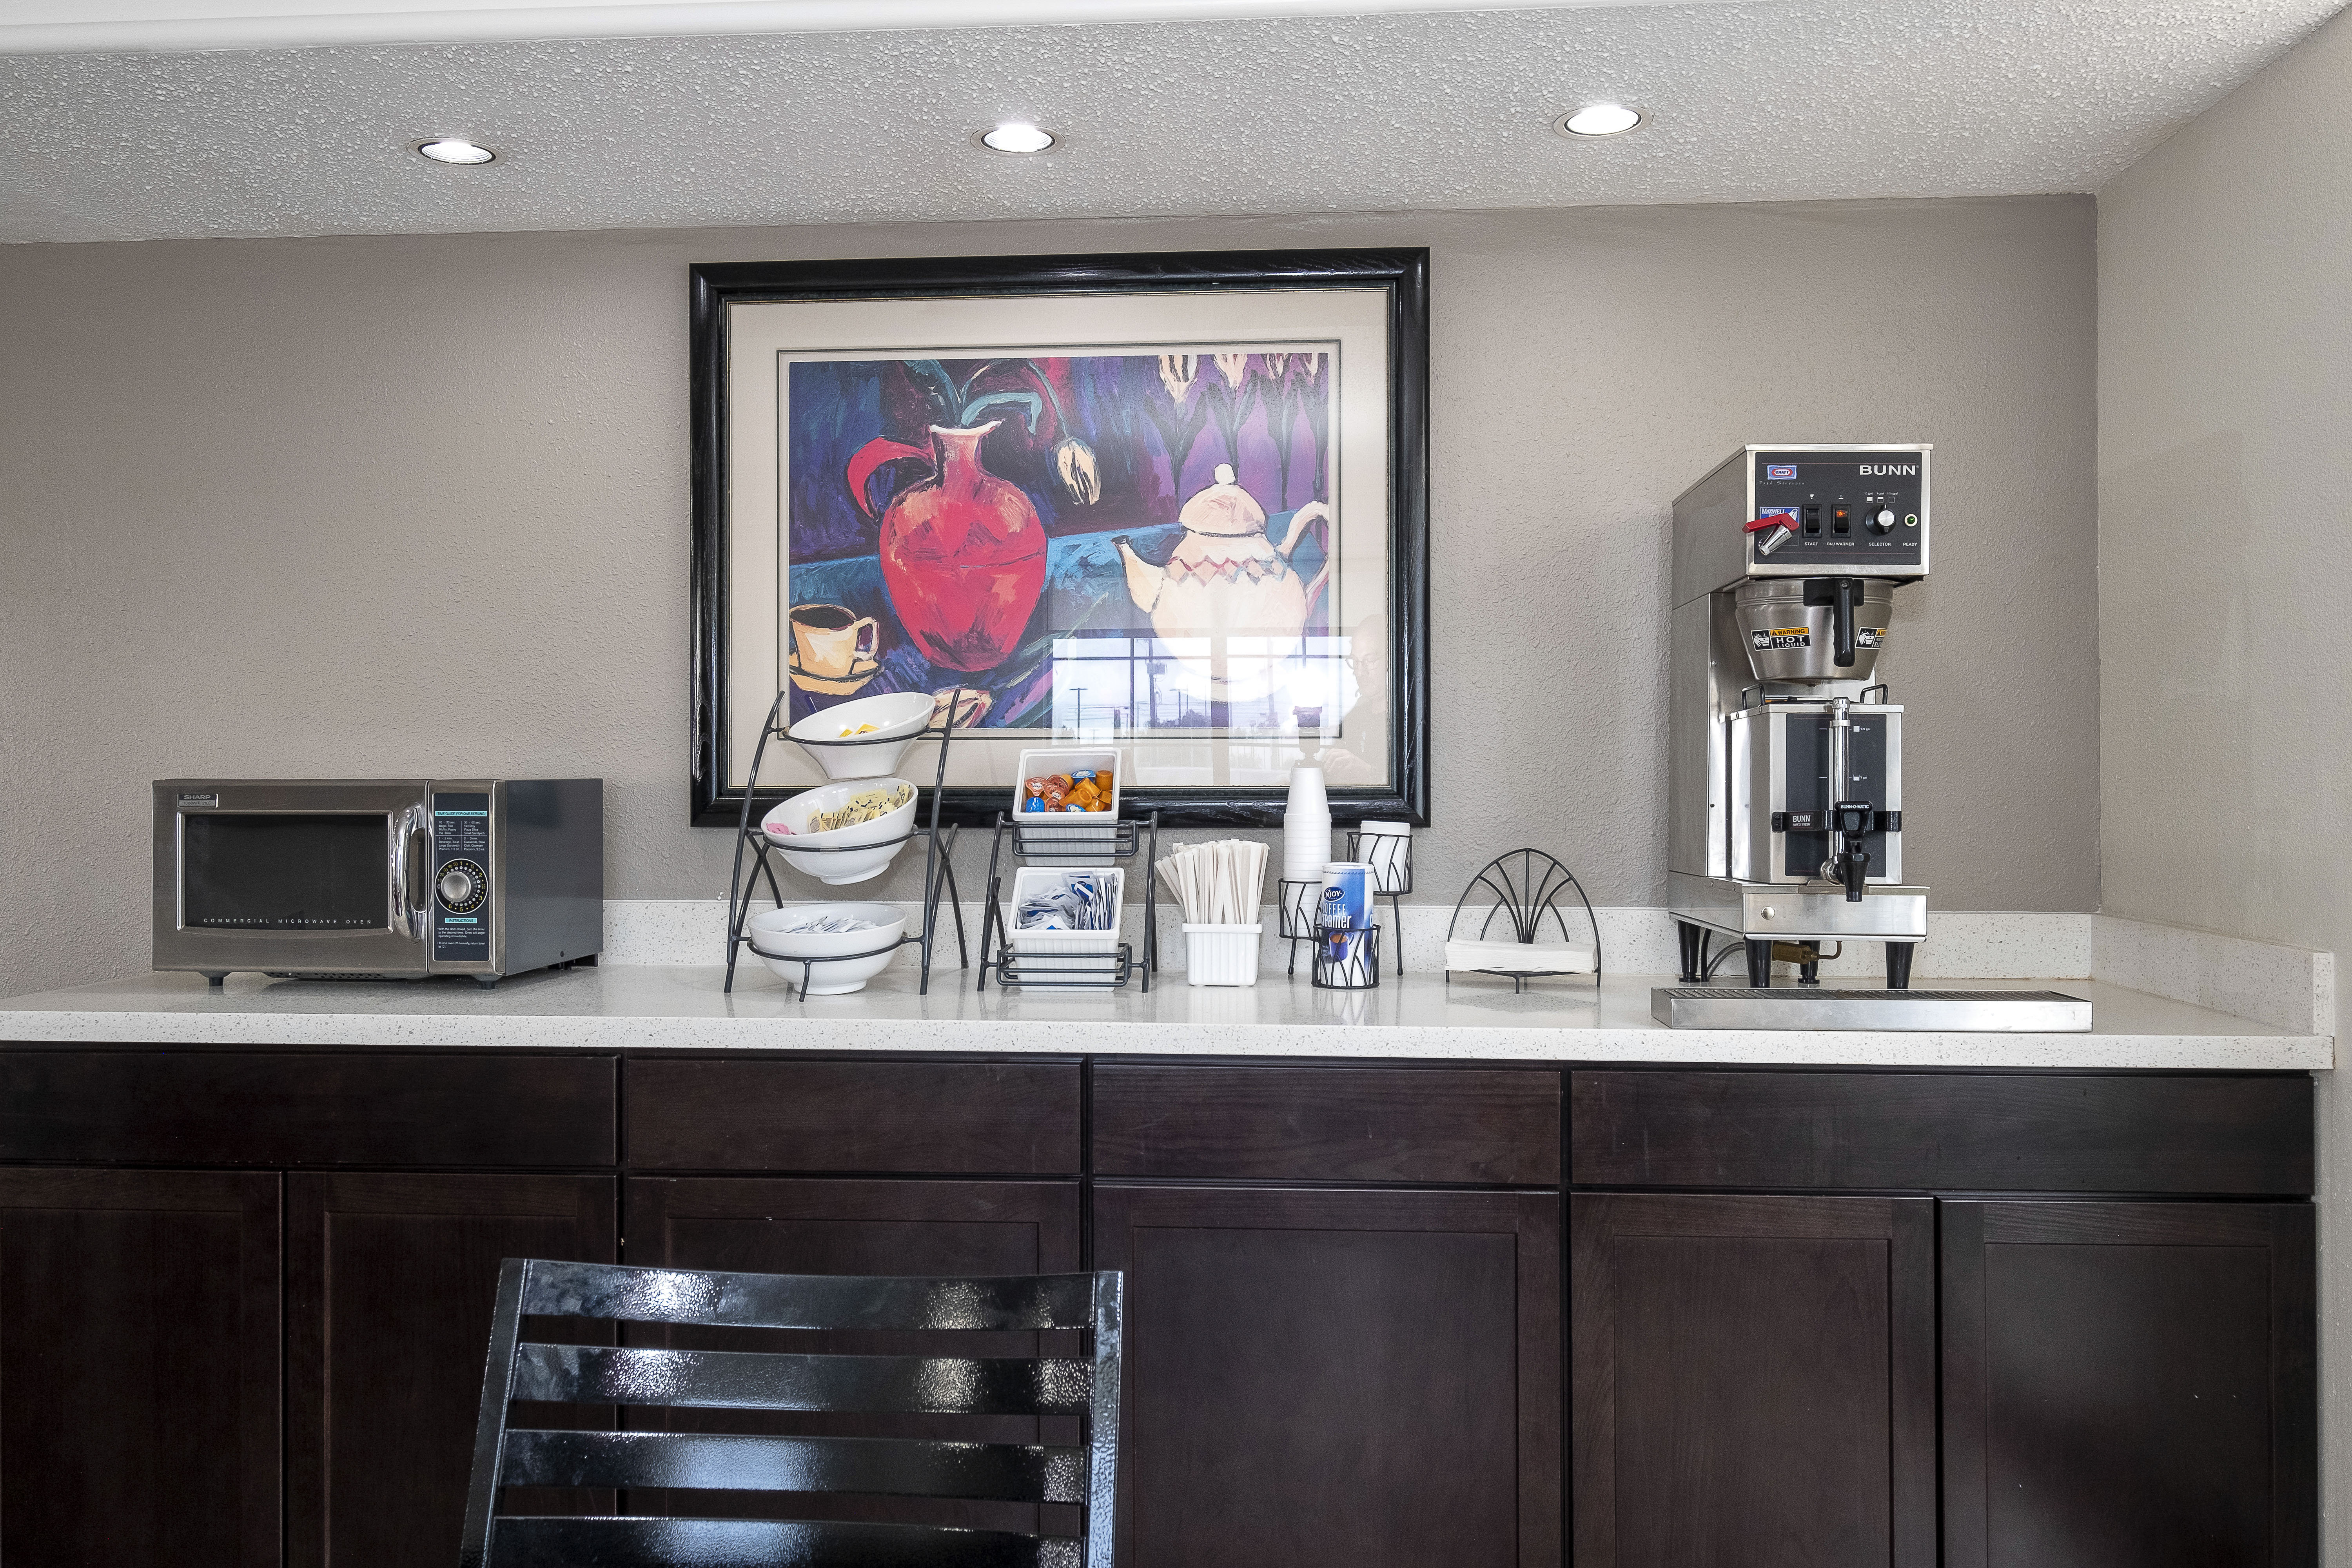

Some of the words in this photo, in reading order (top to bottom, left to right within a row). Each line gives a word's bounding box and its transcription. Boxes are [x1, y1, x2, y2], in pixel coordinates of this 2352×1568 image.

[1860, 465, 1916, 475] BUNN
[1323, 903, 1346, 915] COFFEE
[1321, 914, 1352, 929] reamer
